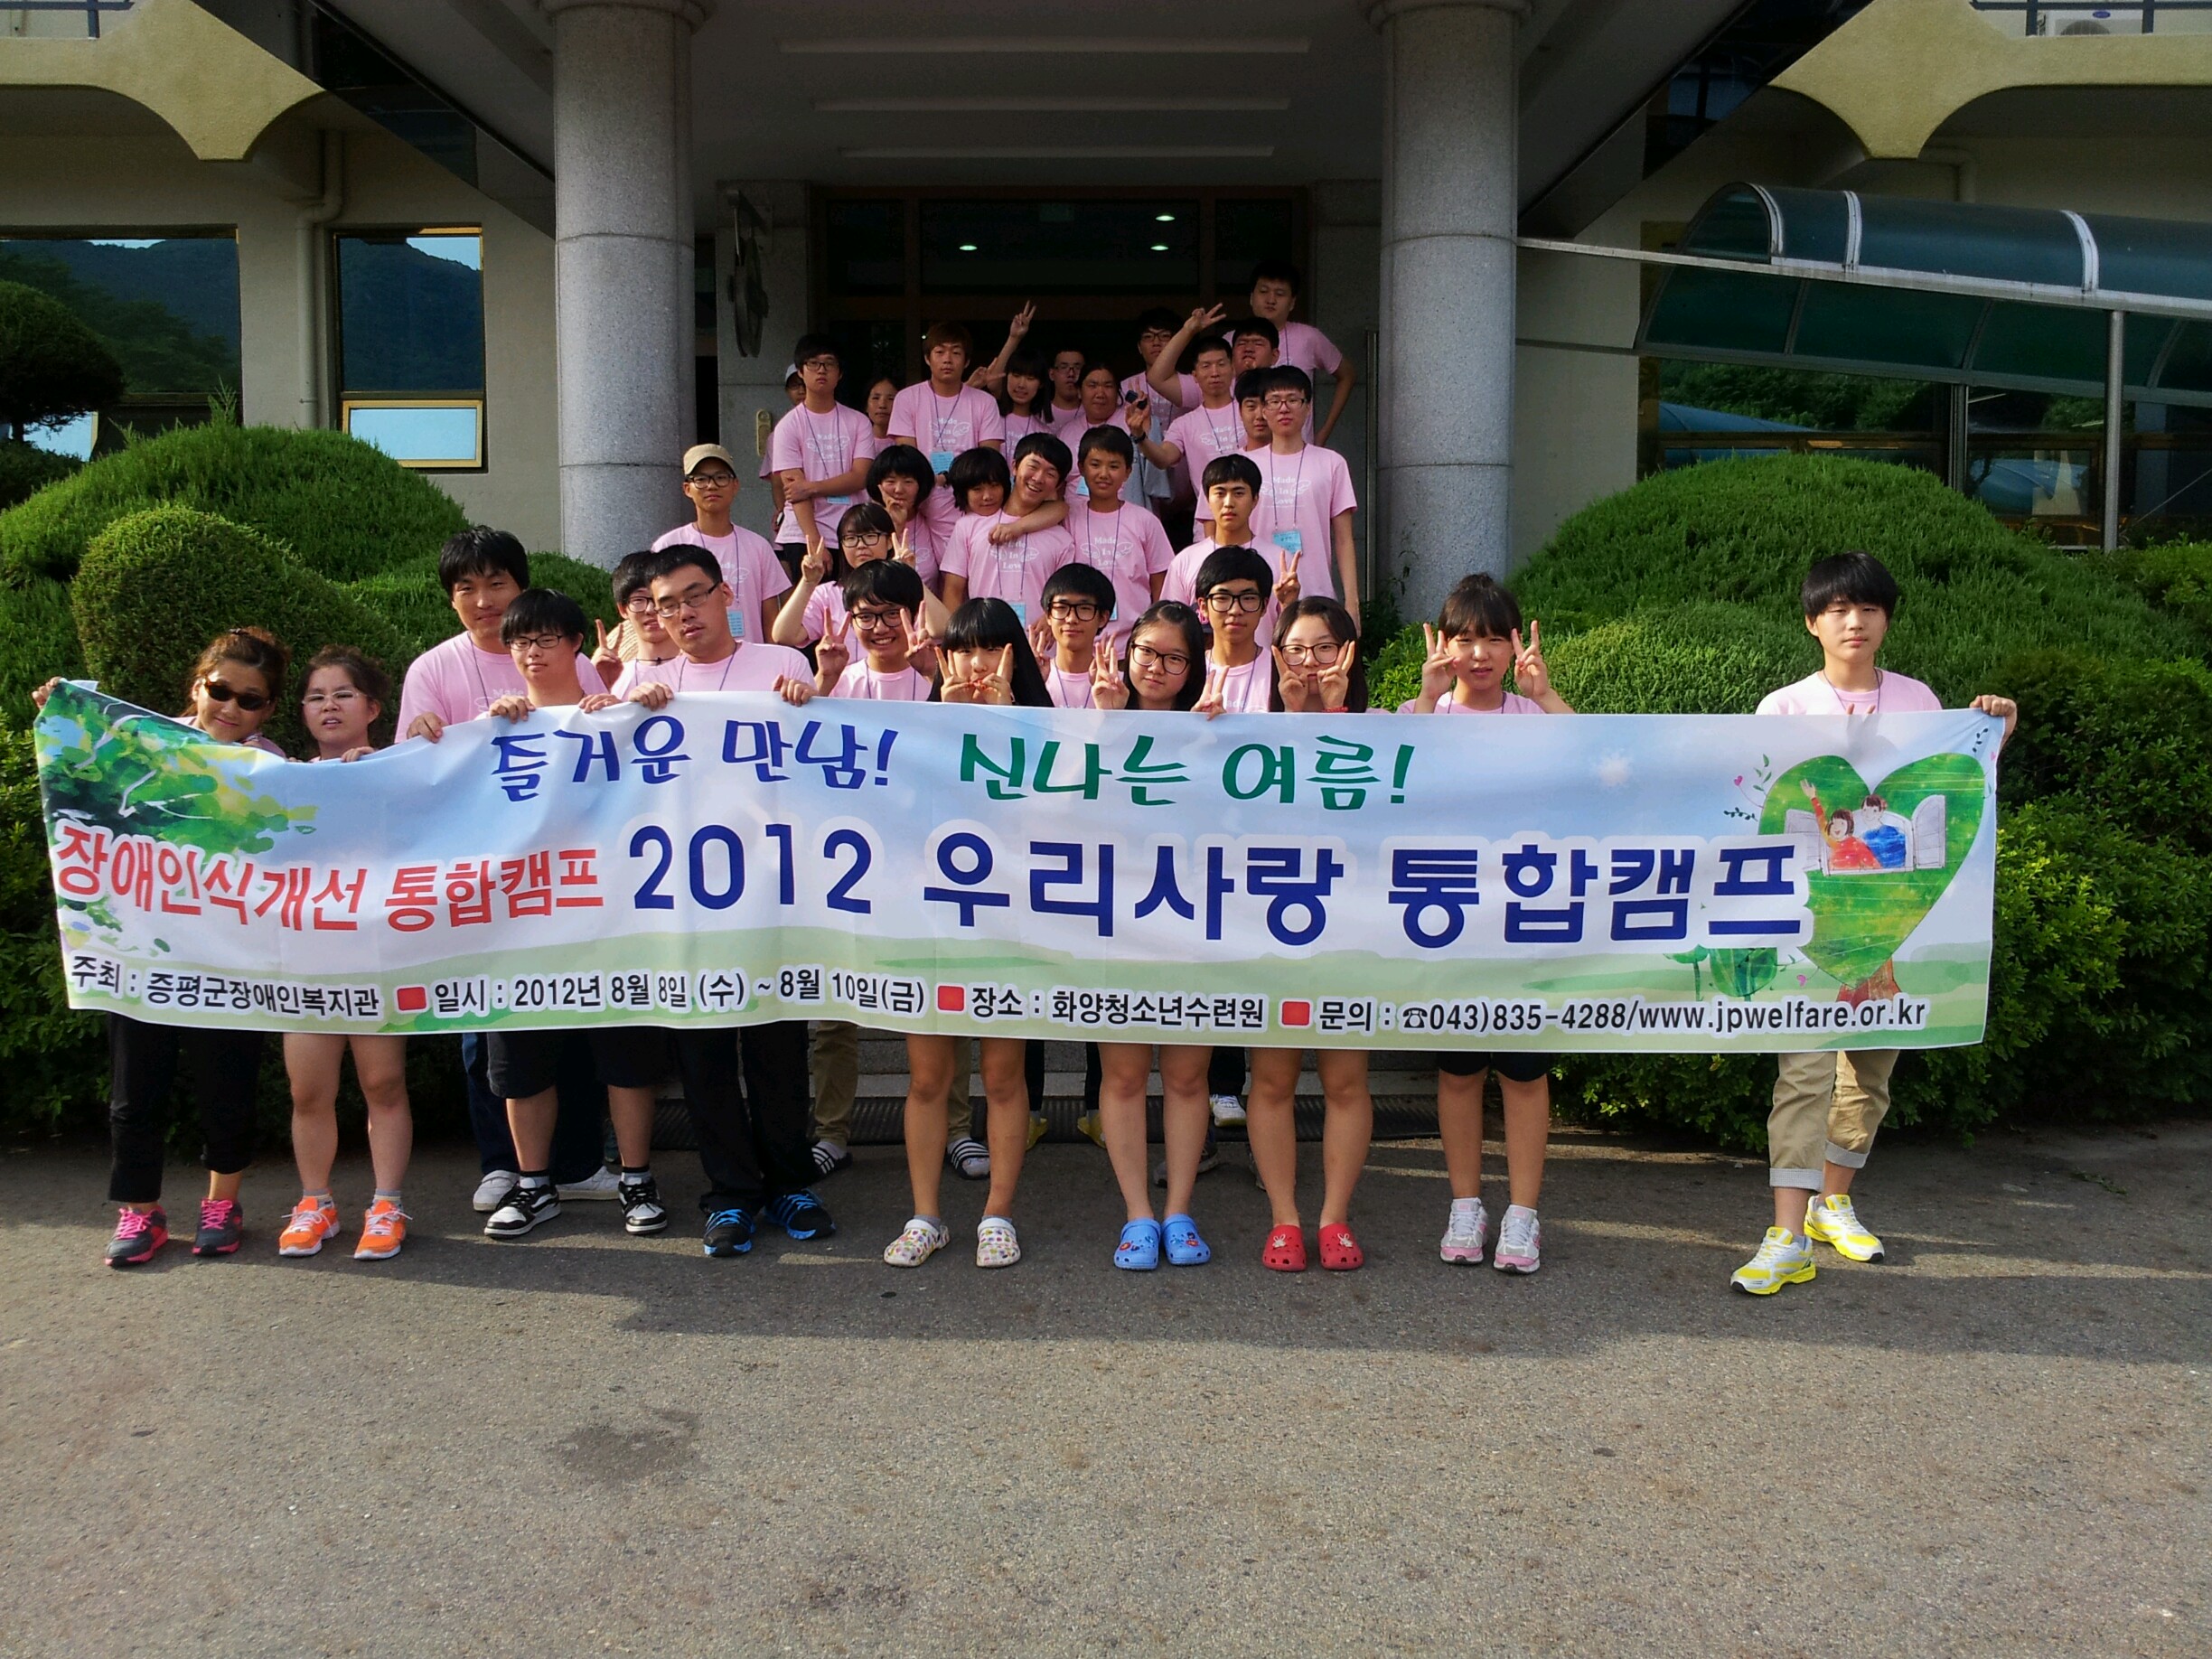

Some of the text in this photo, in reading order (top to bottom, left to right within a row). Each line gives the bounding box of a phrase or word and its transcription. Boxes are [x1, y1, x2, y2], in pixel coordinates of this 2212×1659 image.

[491, 715, 1415, 811] 즐거운 만남! 신나는 여름!
[60, 828, 603, 932] 장애인식개선 통합캠프
[629, 823, 1801, 949] 2012 우리사랑 통합캠프
[147, 972, 380, 1017] 증평군장애인복지관
[515, 975, 601, 1007] 2012년
[611, 974, 650, 1006] 8월
[659, 976, 687, 1008] 8일
[780, 969, 820, 999] 8월
[1052, 990, 1263, 1028] 화양청소년수련원
